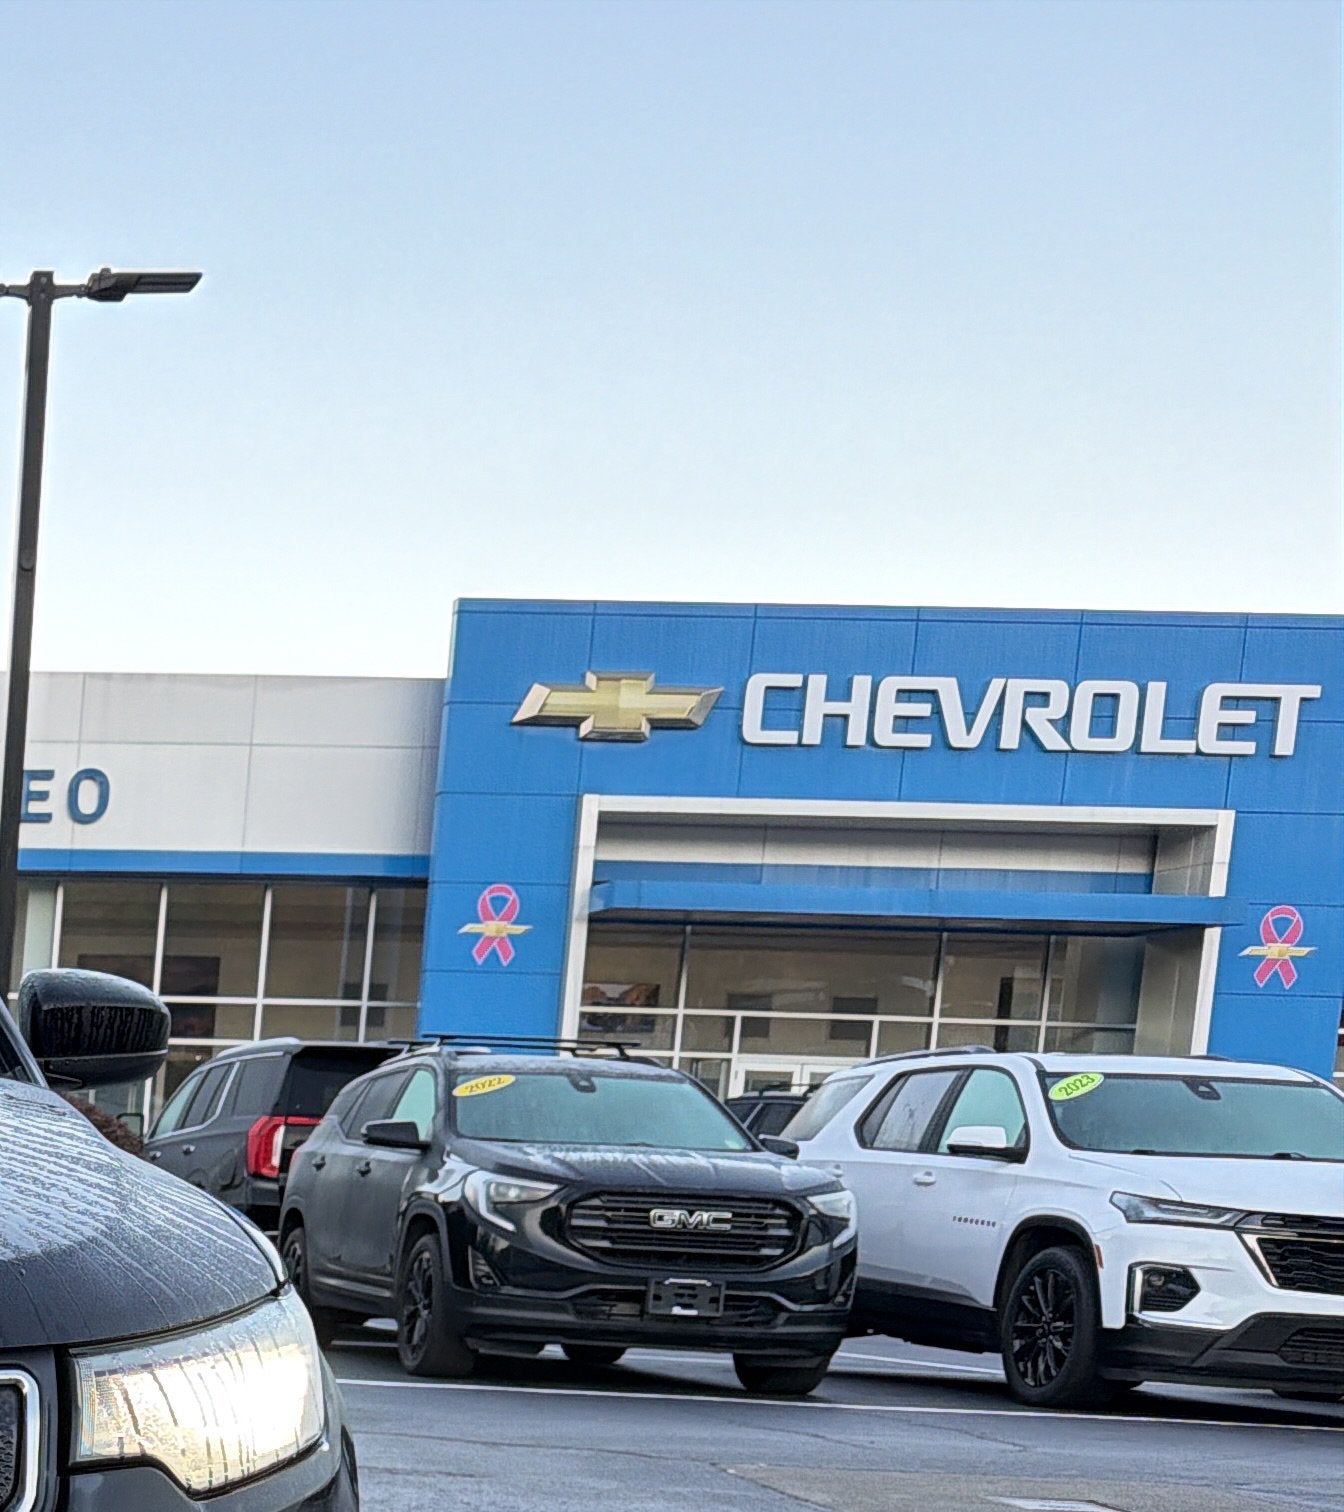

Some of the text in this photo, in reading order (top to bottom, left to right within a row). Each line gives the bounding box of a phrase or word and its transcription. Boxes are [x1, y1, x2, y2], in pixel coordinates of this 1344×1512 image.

[742, 672, 1322, 757] CHEVROLET
[1058, 1074, 1095, 1096] 2023
[649, 1208, 733, 1231] GMC
